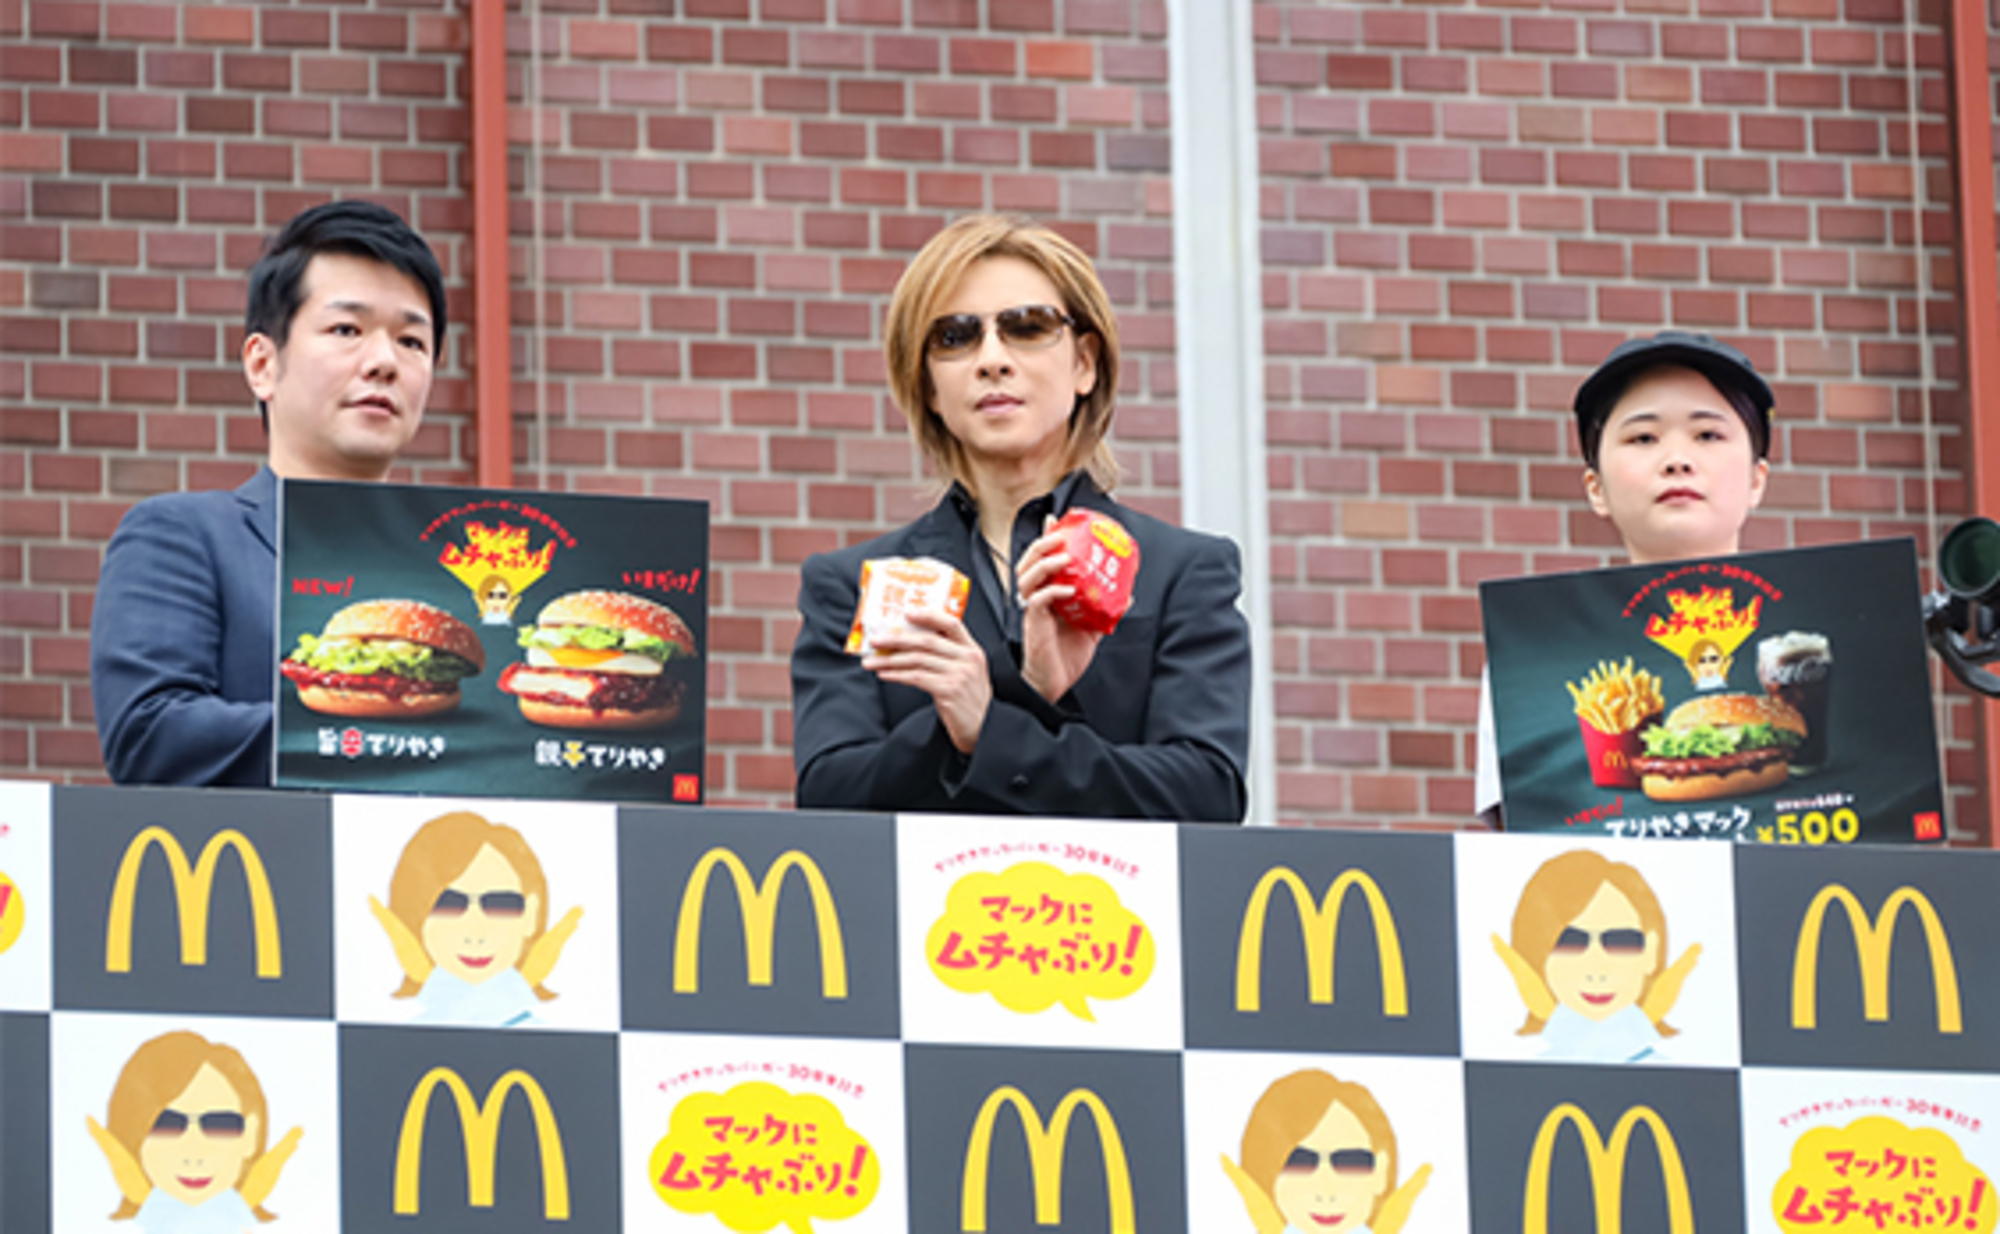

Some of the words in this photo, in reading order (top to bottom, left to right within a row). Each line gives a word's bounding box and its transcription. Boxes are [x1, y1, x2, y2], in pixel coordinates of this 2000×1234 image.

[292, 576, 355, 597] NEW!
[1605, 806, 1751, 839] てりやきマック
[1757, 808, 1859, 845] ¥500
[981, 894, 1092, 924] マックに
[936, 925, 1142, 976] ムチャぶり!
[704, 1114, 817, 1145] マックに
[659, 1145, 867, 1197] ムチャぶり!
[1825, 1148, 1937, 1179] マックに
[1782, 1178, 1986, 1230] ムチャぶり!
